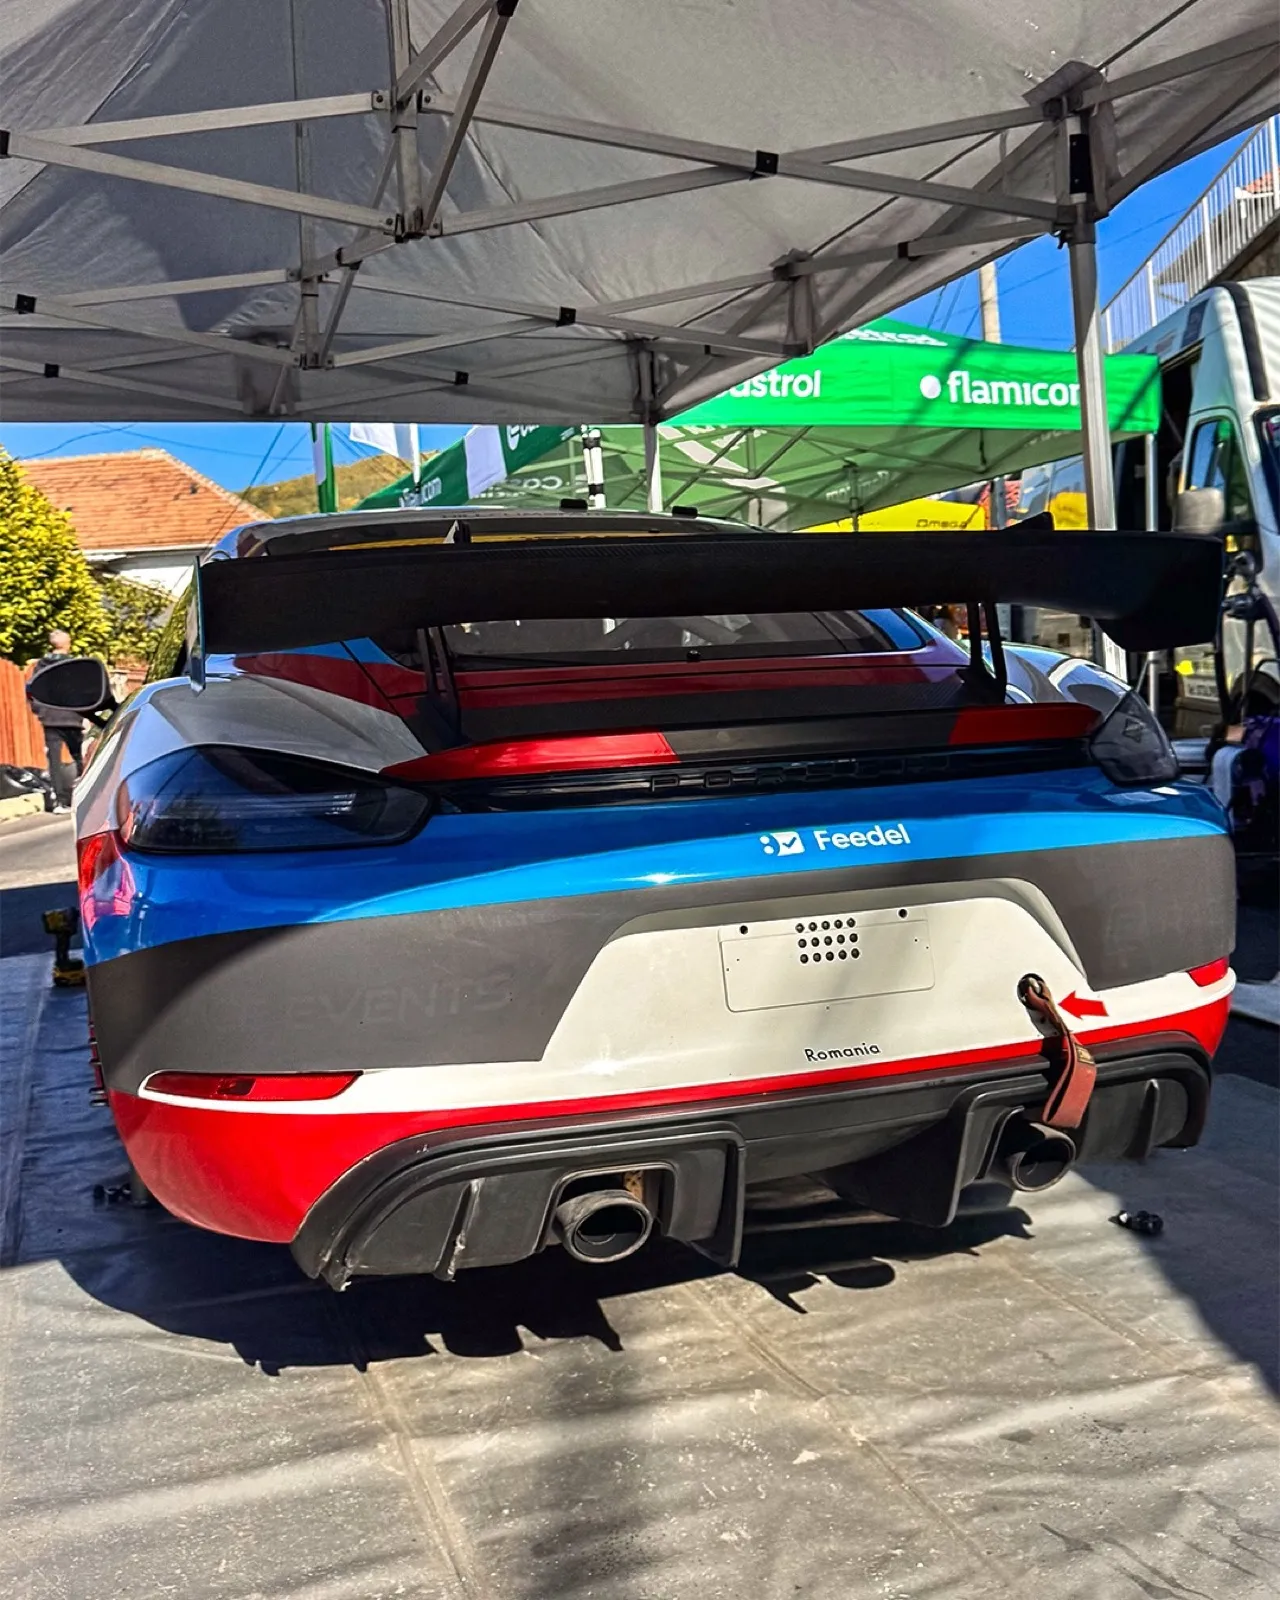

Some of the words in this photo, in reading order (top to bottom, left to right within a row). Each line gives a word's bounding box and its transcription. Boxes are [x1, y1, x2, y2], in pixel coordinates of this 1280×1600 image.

[715, 368, 822, 398] astrol
[813, 823, 912, 851] Feedel
[804, 1042, 881, 1062] Romania
